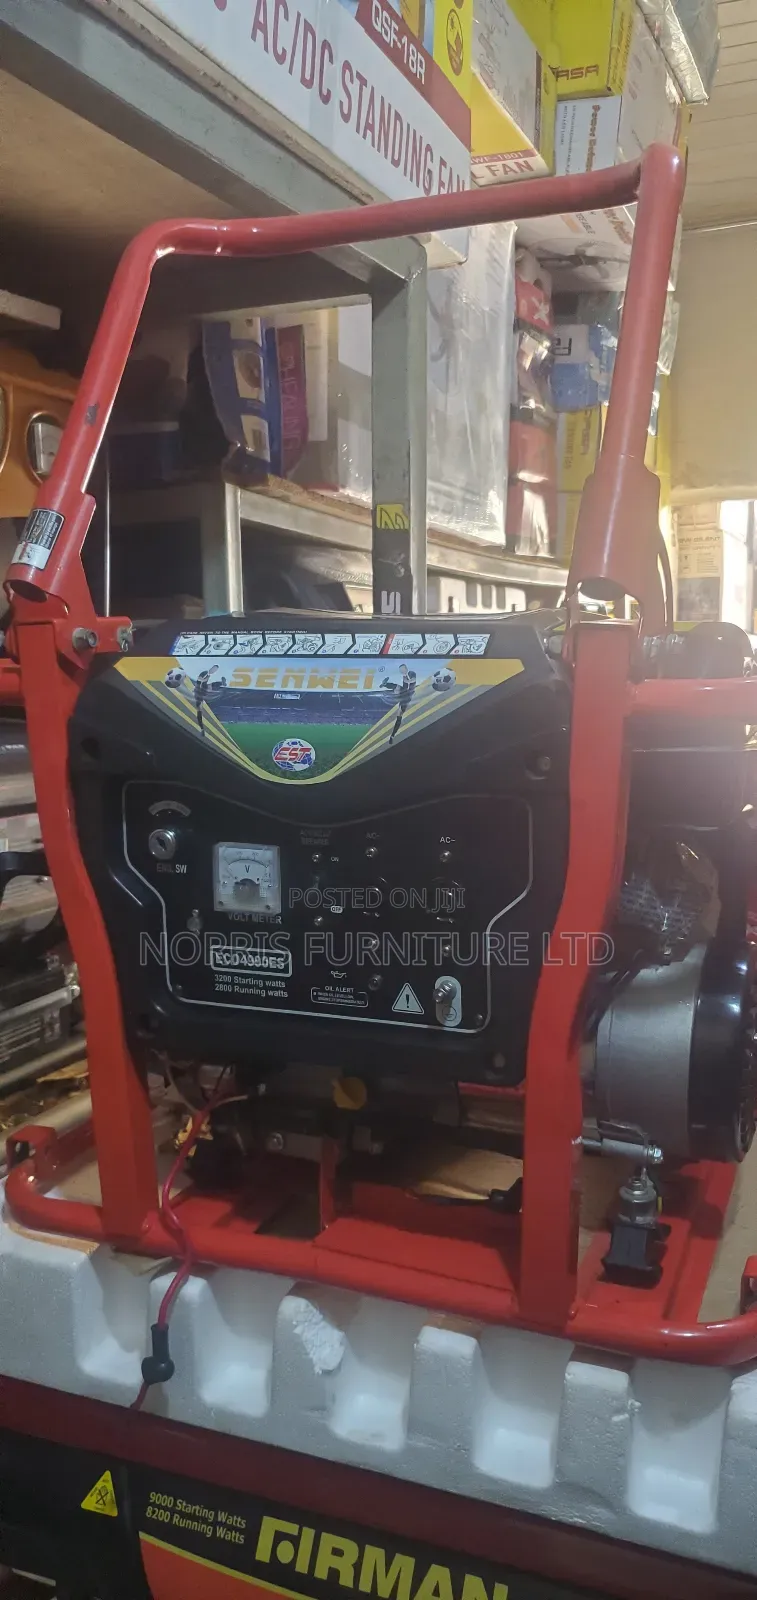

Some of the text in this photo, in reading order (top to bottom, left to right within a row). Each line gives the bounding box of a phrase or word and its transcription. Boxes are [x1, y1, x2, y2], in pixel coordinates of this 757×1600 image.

[371, 0, 426, 85] QSF-18R
[554, 64, 599, 82] ASA
[251, 0, 334, 105] AC/DC
[339, 60, 434, 196] STANDING
[469, 151, 523, 164] WF-1801
[485, 160, 535, 177] FAN
[229, 667, 374, 689] SENWEI
[273, 747, 313, 762] EST
[175, 864, 188, 874] SW
[244, 864, 250, 873] V
[227, 912, 282, 925] VOLT METER
[214, 974, 286, 988] 3200 Starting watts
[214, 983, 289, 998] 2800 Running watts
[149, 1491, 246, 1530] 9000 Starting Watts
[145, 1505, 245, 1545] 8200 Running Watts
